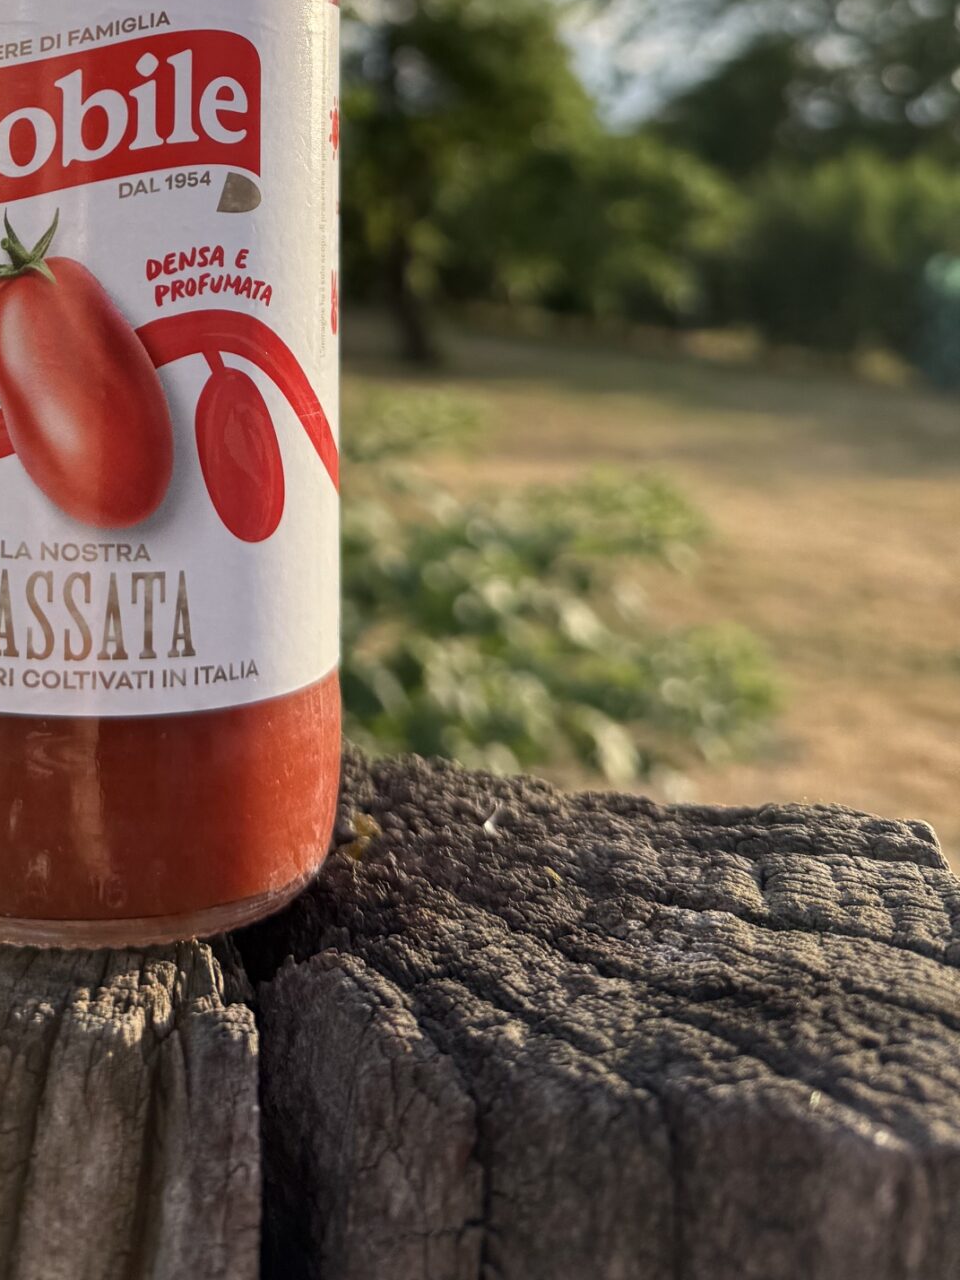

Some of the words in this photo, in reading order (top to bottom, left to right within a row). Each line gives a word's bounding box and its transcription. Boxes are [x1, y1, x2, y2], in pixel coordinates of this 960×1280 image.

[39, 34, 62, 53] DI
[68, 11, 171, 46] FAMIGLIA
[119, 177, 160, 200] DAL
[165, 170, 212, 192] 1954
[146, 244, 224, 281] DENSA
[234, 248, 249, 269] E
[155, 272, 272, 308] PROFUMATA
[0, 539, 32, 561] LA
[40, 541, 152, 563] NOSTRA
[22, 667, 154, 691] COLTIVATI
[162, 666, 186, 688] IN
[194, 659, 259, 686] ITALIA
